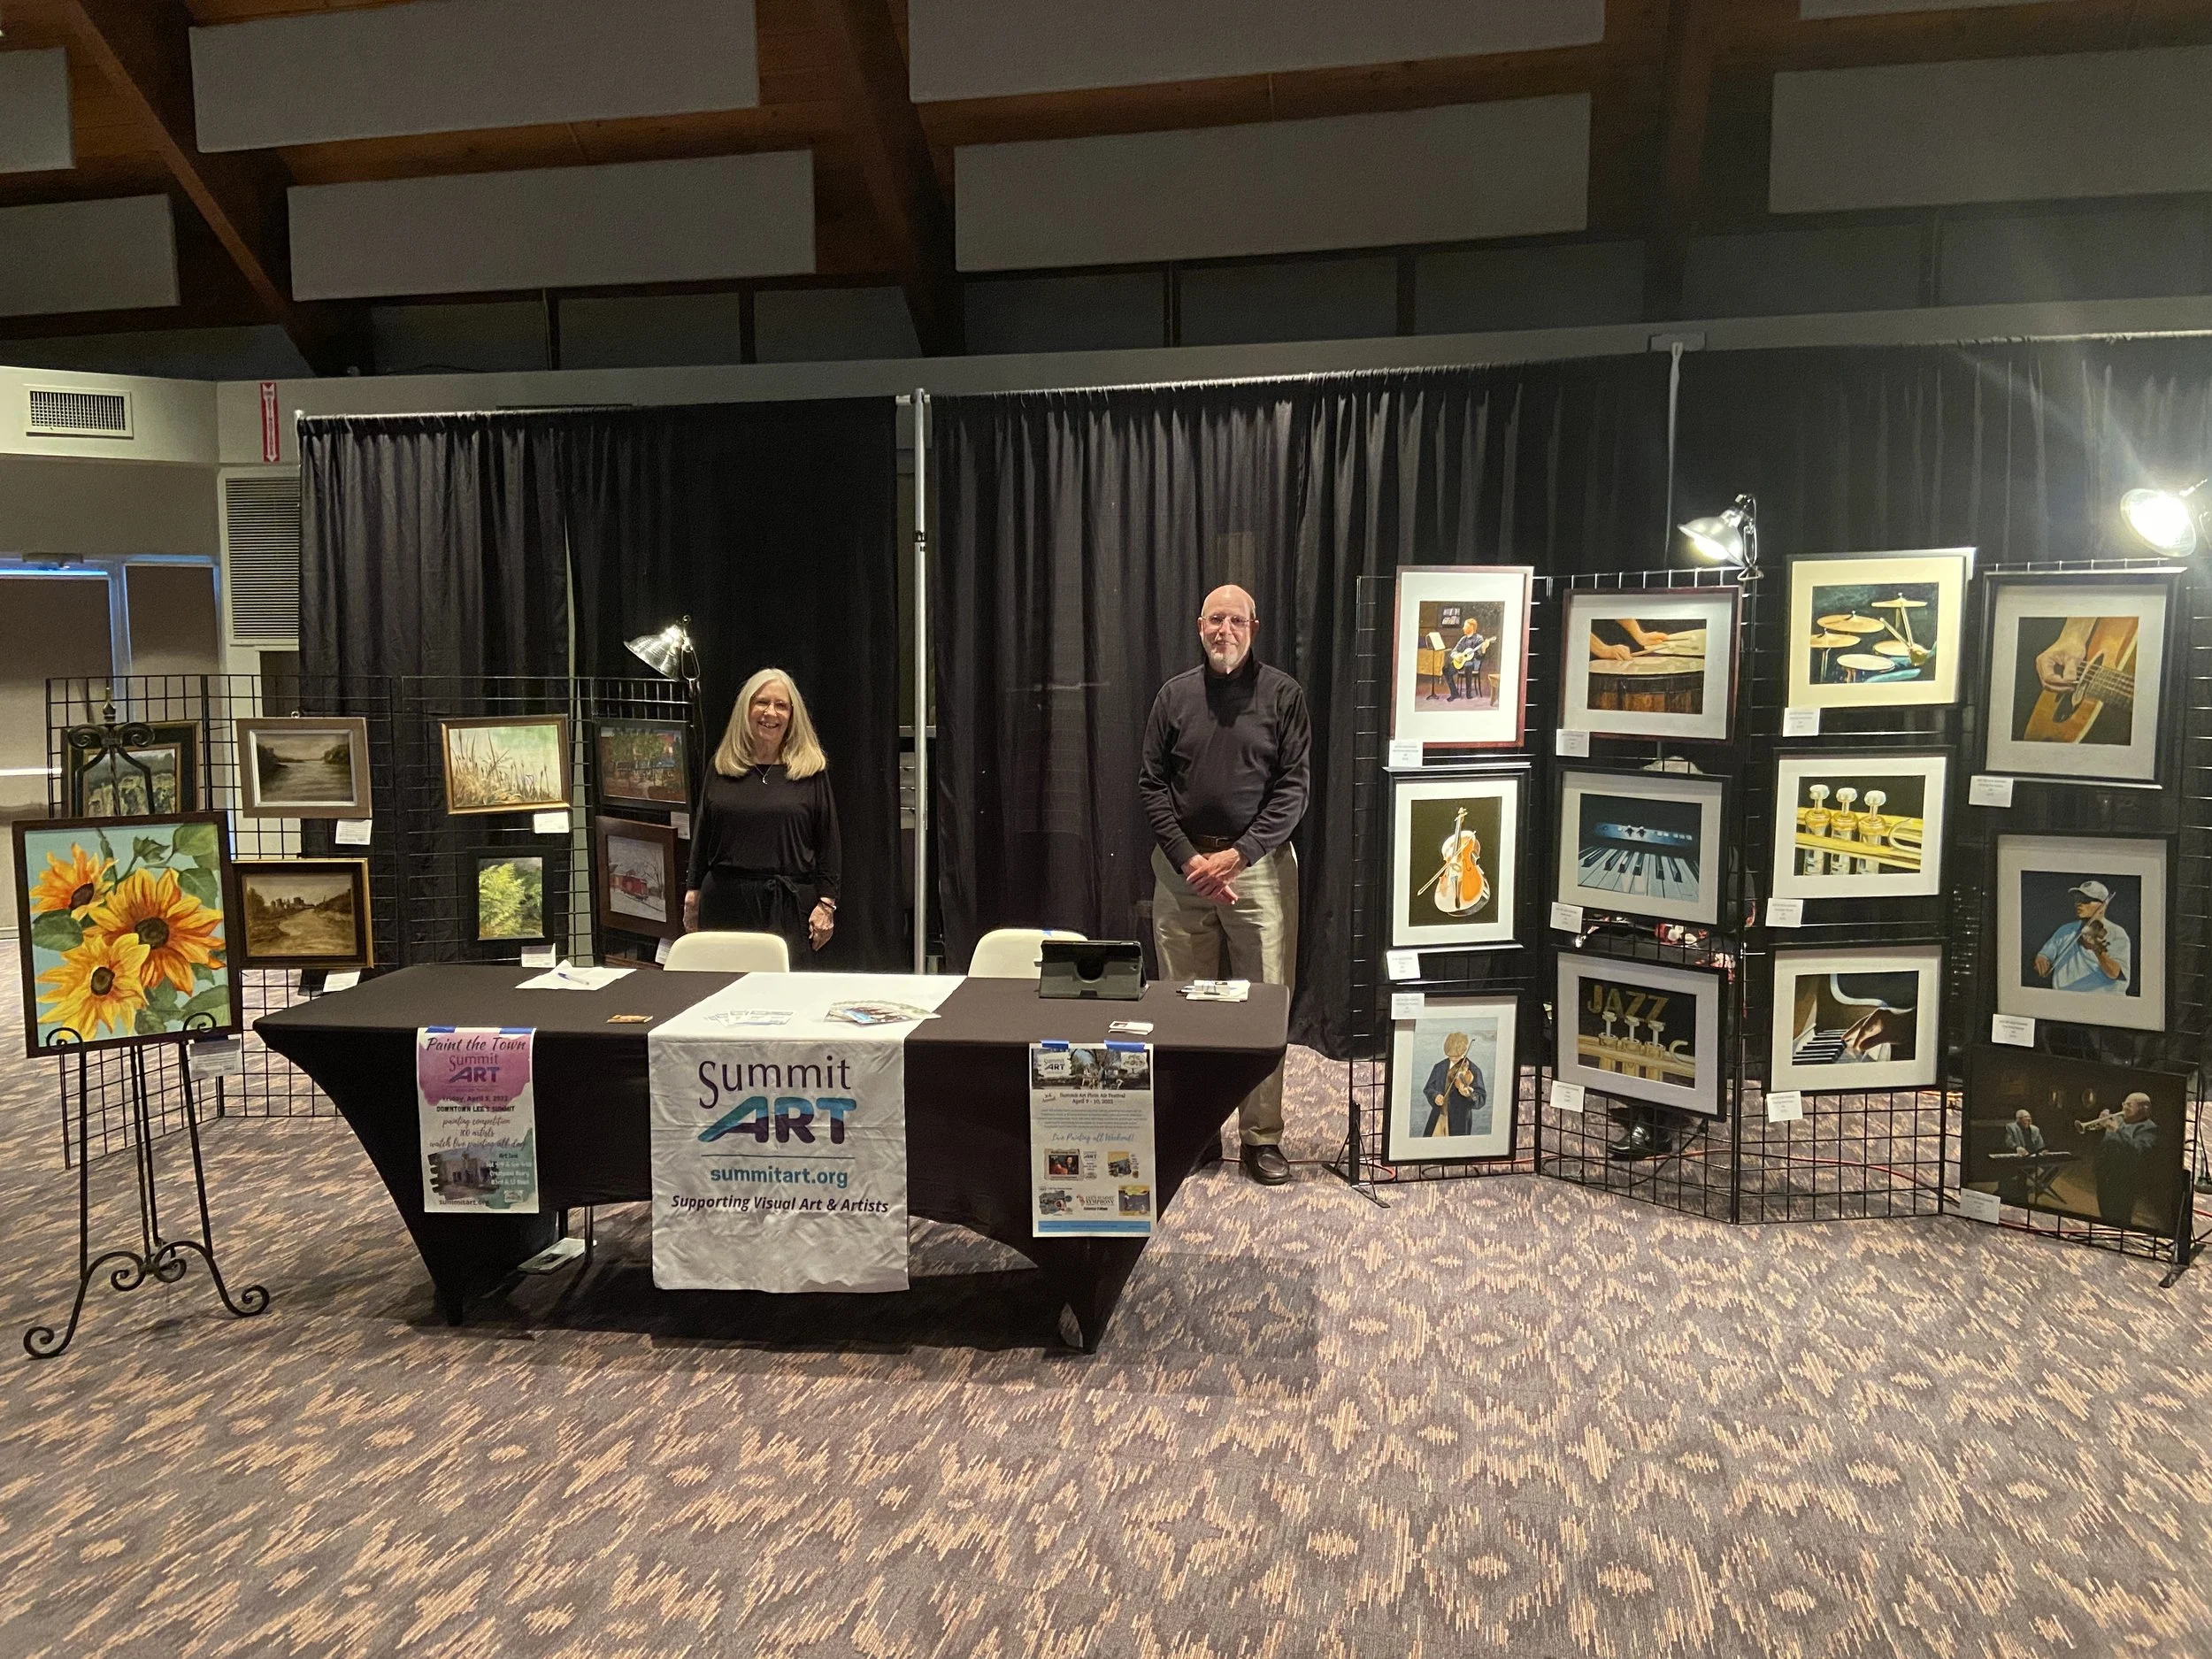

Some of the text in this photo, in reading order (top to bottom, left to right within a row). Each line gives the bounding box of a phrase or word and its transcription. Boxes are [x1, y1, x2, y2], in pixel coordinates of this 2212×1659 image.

[1587, 985, 1670, 1025] JAZZ
[426, 1035, 526, 1051] Paint the Town
[449, 1052, 498, 1071] Summit
[449, 1066, 501, 1083] ART
[698, 1055, 851, 1110] Summit
[472, 1116, 511, 1127] competition
[697, 1095, 857, 1145] ART
[710, 1165, 848, 1188] summitart.org
[671, 1194, 889, 1213] Supporting Visual Art & Artists
